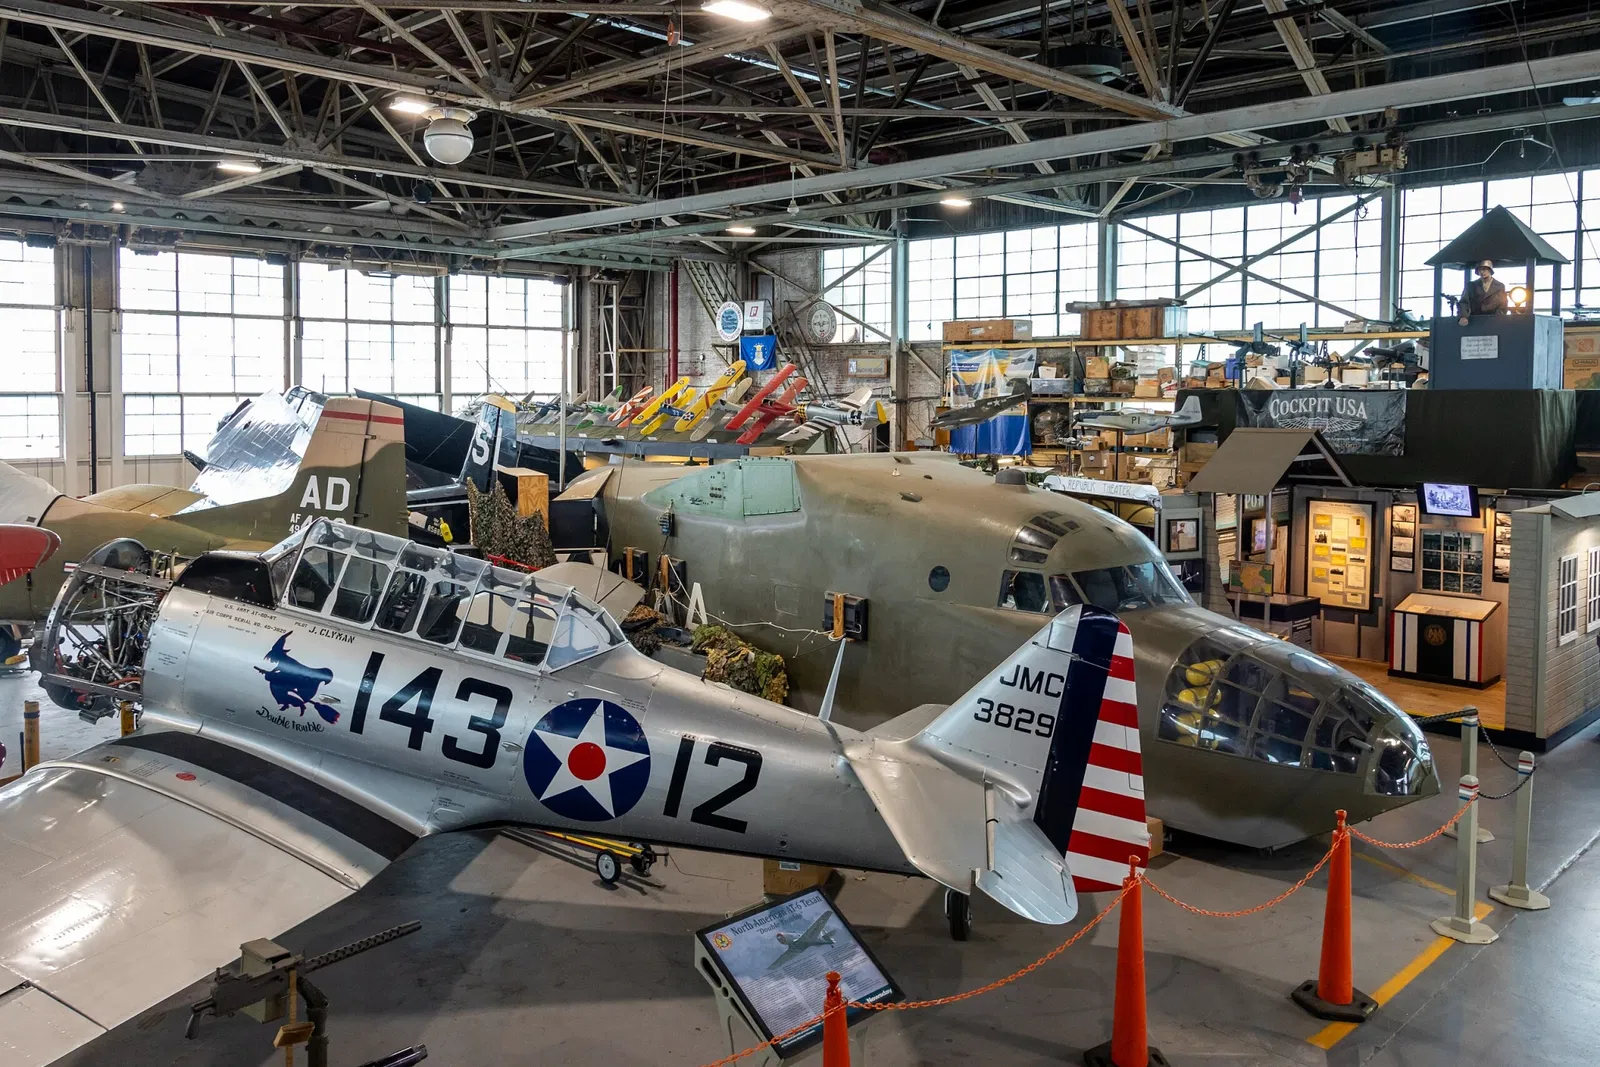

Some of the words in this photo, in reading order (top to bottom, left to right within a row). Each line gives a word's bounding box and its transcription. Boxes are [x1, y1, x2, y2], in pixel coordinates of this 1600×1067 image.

[1269, 397, 1332, 419] COCKPIT
[1336, 397, 1368, 420] USA
[300, 475, 350, 511] AD
[1067, 480, 1096, 493] REPUBLIC
[1103, 483, 1132, 497] THEATER
[290, 512, 301, 523] AF
[215, 611, 233, 621] CORPS
[234, 616, 252, 626] SERIAL
[294, 621, 308, 629] PILOT
[308, 626, 317, 635] J.
[319, 628, 356, 644] CLYMAN
[1000, 664, 1065, 698] JMC
[255, 706, 290, 729] Double
[349, 651, 513, 770] 143
[974, 697, 1055, 738] 3829
[663, 735, 763, 834] 12
[730, 921, 754, 937] North
[786, 900, 802, 914] AT-6
[800, 895, 823, 909] Texan
